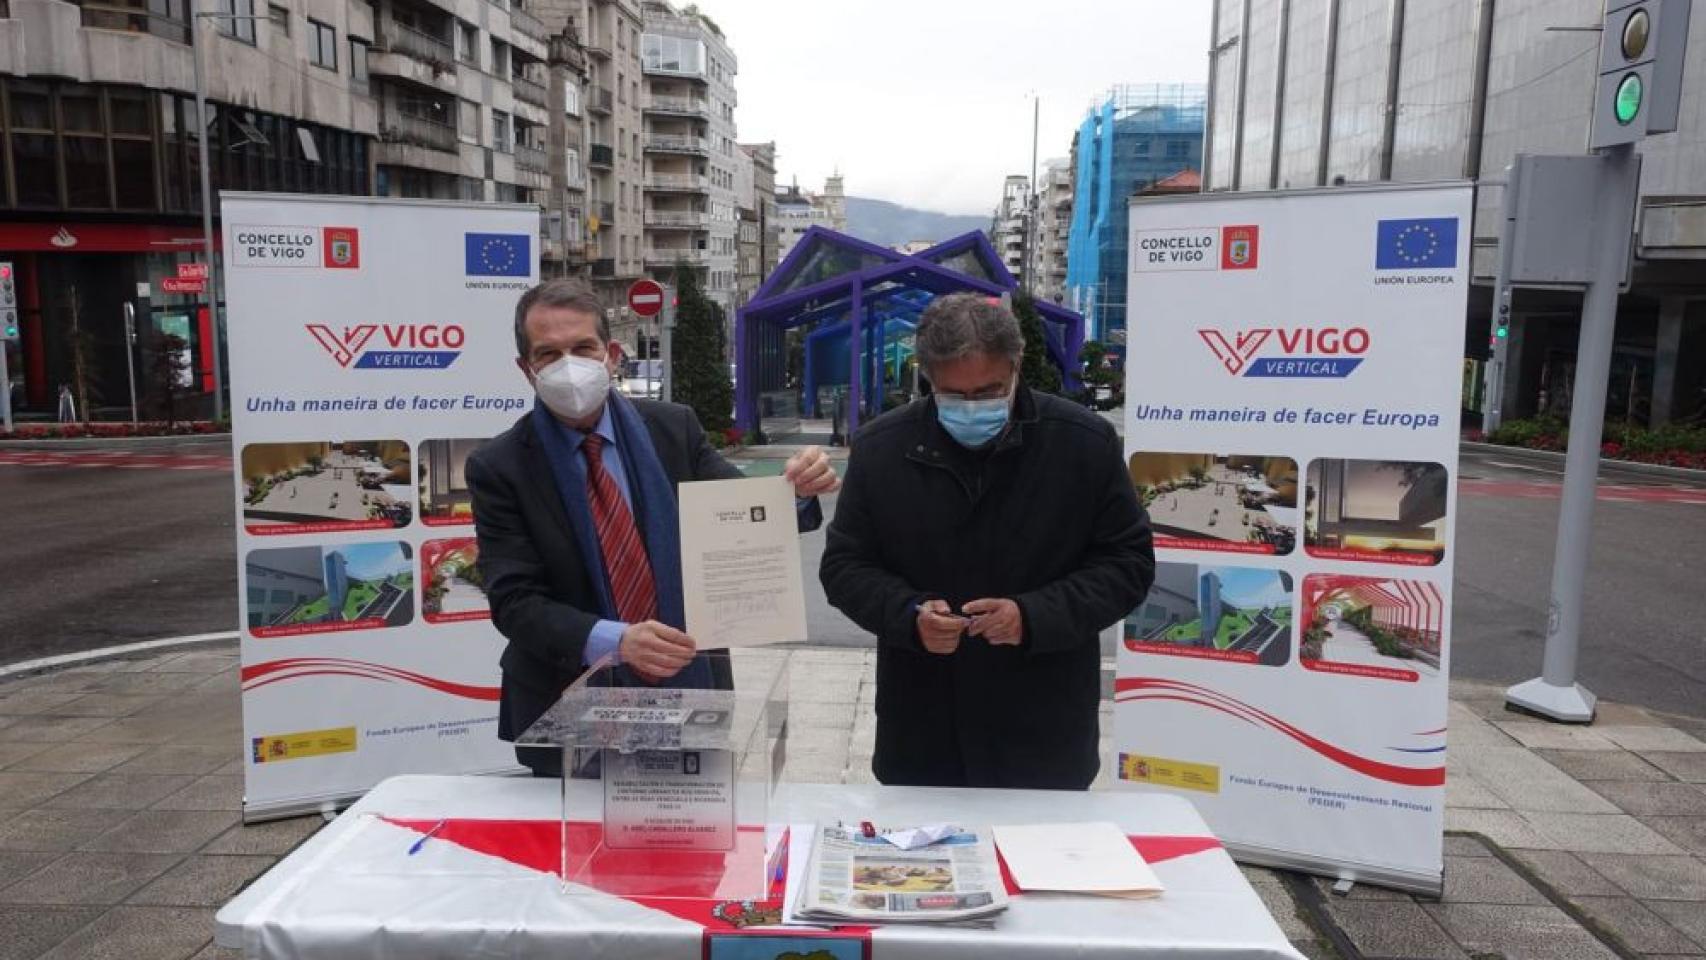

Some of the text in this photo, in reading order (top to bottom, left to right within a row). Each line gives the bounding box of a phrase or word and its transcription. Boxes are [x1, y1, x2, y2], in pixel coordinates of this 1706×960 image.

[238, 233, 313, 246] CONCELLO
[1141, 237, 1212, 249] CONCELLO
[248, 247, 305, 258] DE VIGO
[1149, 251, 1203, 262] DE VIGO
[465, 282, 530, 290] UNIÓN EUROPEA
[1375, 275, 1454, 285] UNIÓN EUROPEA
[382, 325, 464, 348] VIGO
[1277, 328, 1370, 354] VIGO
[374, 355, 441, 366] VERTICAL
[1266, 361, 1339, 374] VERTICAL
[246, 395, 525, 412] Unha maneira de facer Europa
[1136, 405, 1440, 429] Unha maneira de facer Europa
[1229, 775, 1256, 785] Fondo
[1258, 779, 1294, 792] Europeo
[1296, 785, 1307, 794] de
[1391, 800, 1432, 813] Regional
